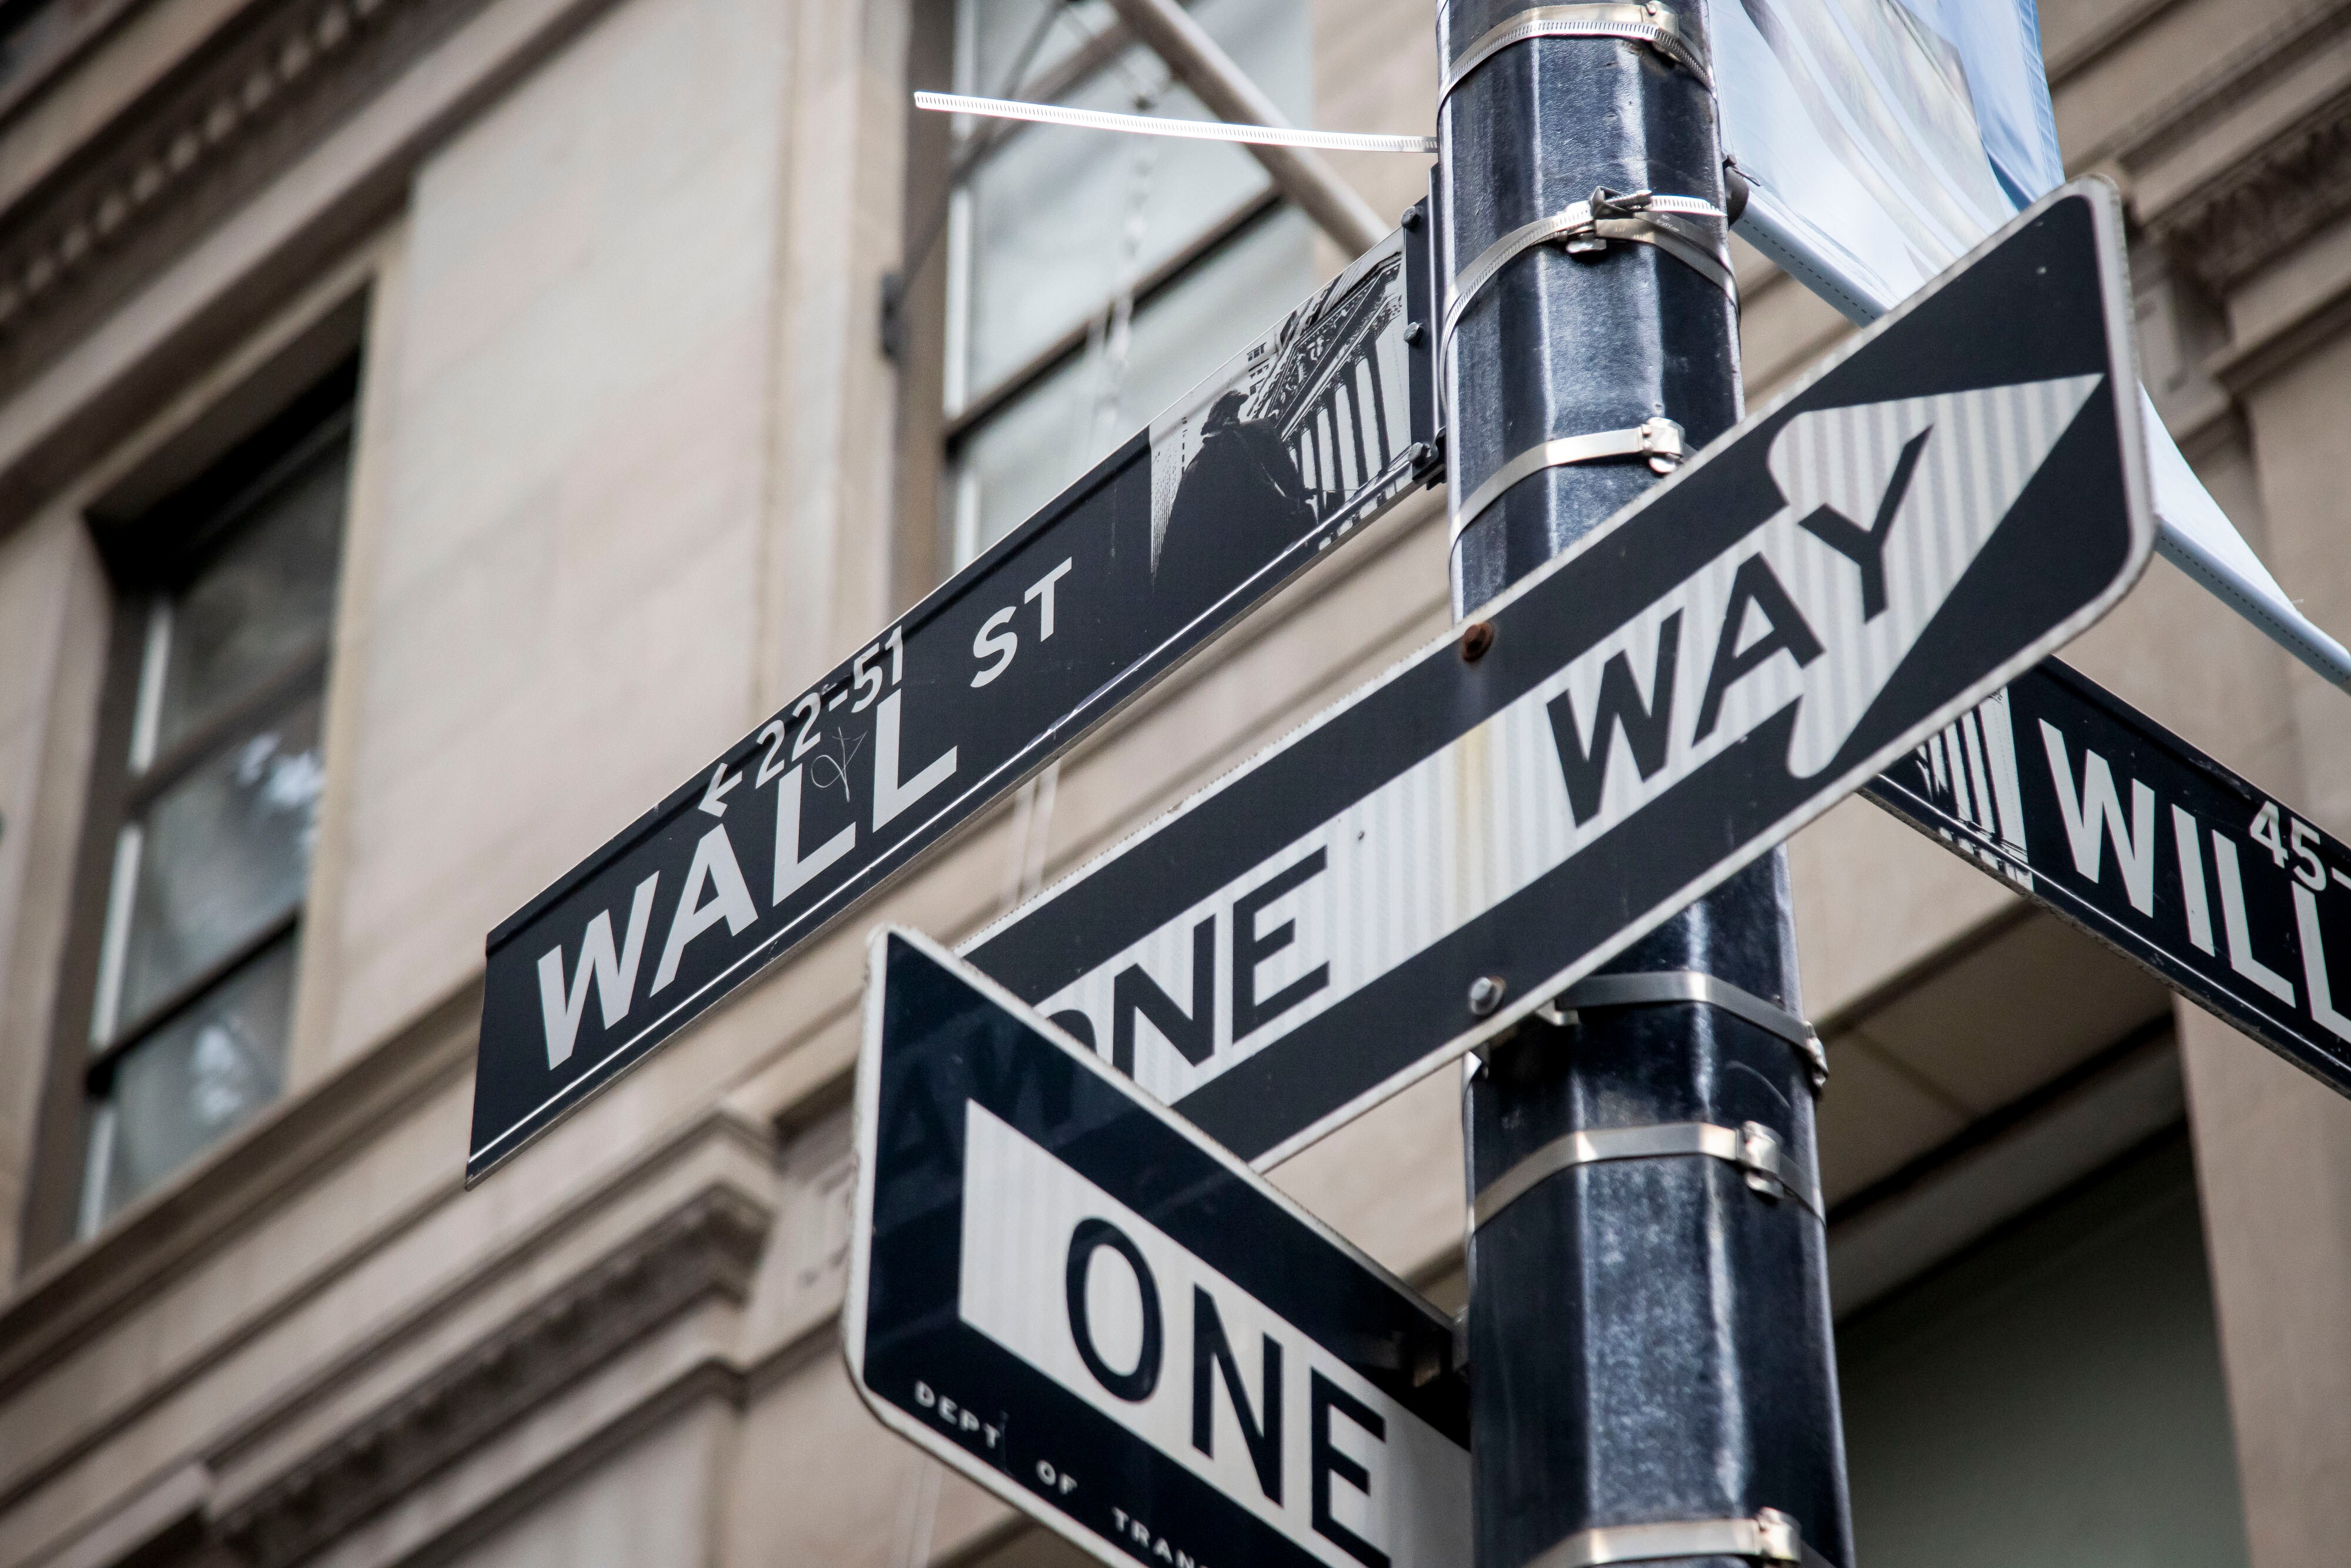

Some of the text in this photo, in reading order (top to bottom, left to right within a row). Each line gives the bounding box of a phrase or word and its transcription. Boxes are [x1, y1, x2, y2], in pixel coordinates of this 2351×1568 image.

[536, 555, 1073, 1071] WALL ST
[755, 625, 903, 790] 22-51
[1045, 424, 1934, 1083] NE WAY
[2038, 718, 2351, 1044] WILL
[915, 1381, 1209, 1568] DEPT OF TRAN
[1065, 1217, 1391, 1568] ONE
